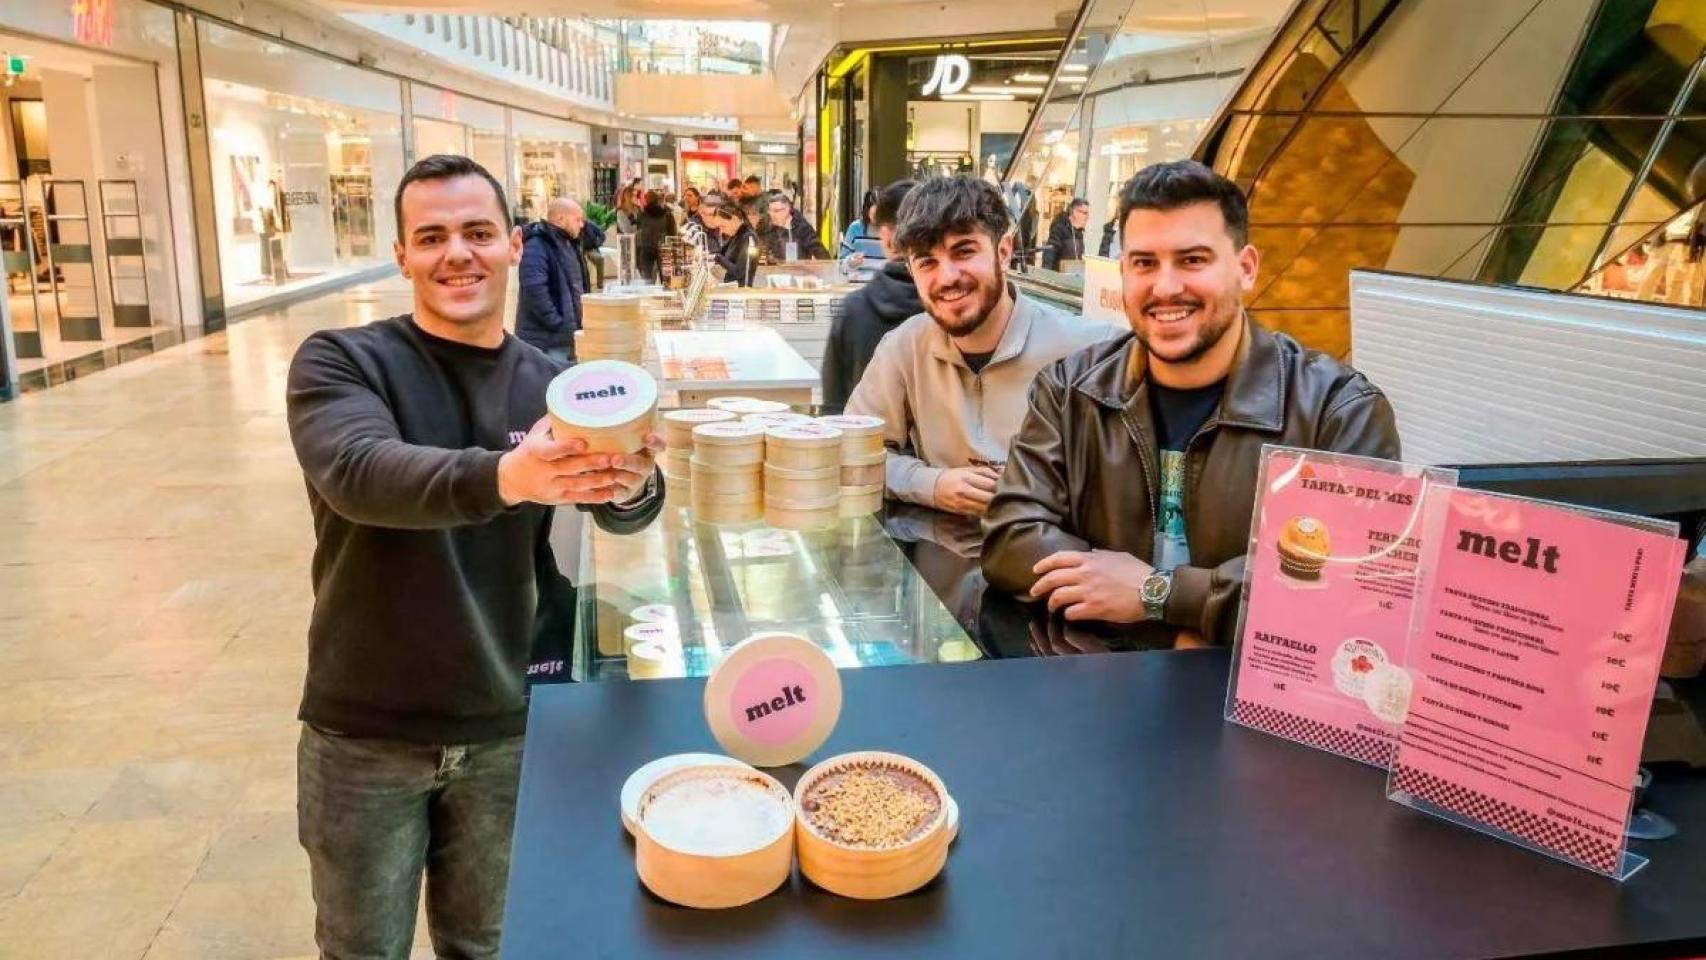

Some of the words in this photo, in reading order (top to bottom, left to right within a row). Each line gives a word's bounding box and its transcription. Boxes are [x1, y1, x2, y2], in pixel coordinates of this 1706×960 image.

[922, 54, 970, 96] JD
[575, 385, 627, 400] melt
[1355, 487, 1381, 500] DEL
[1456, 529, 1560, 574] melt
[1254, 631, 1317, 654] RAFFAELLO
[745, 684, 806, 722] melt
[1547, 807, 1618, 840] @melt.cakes
